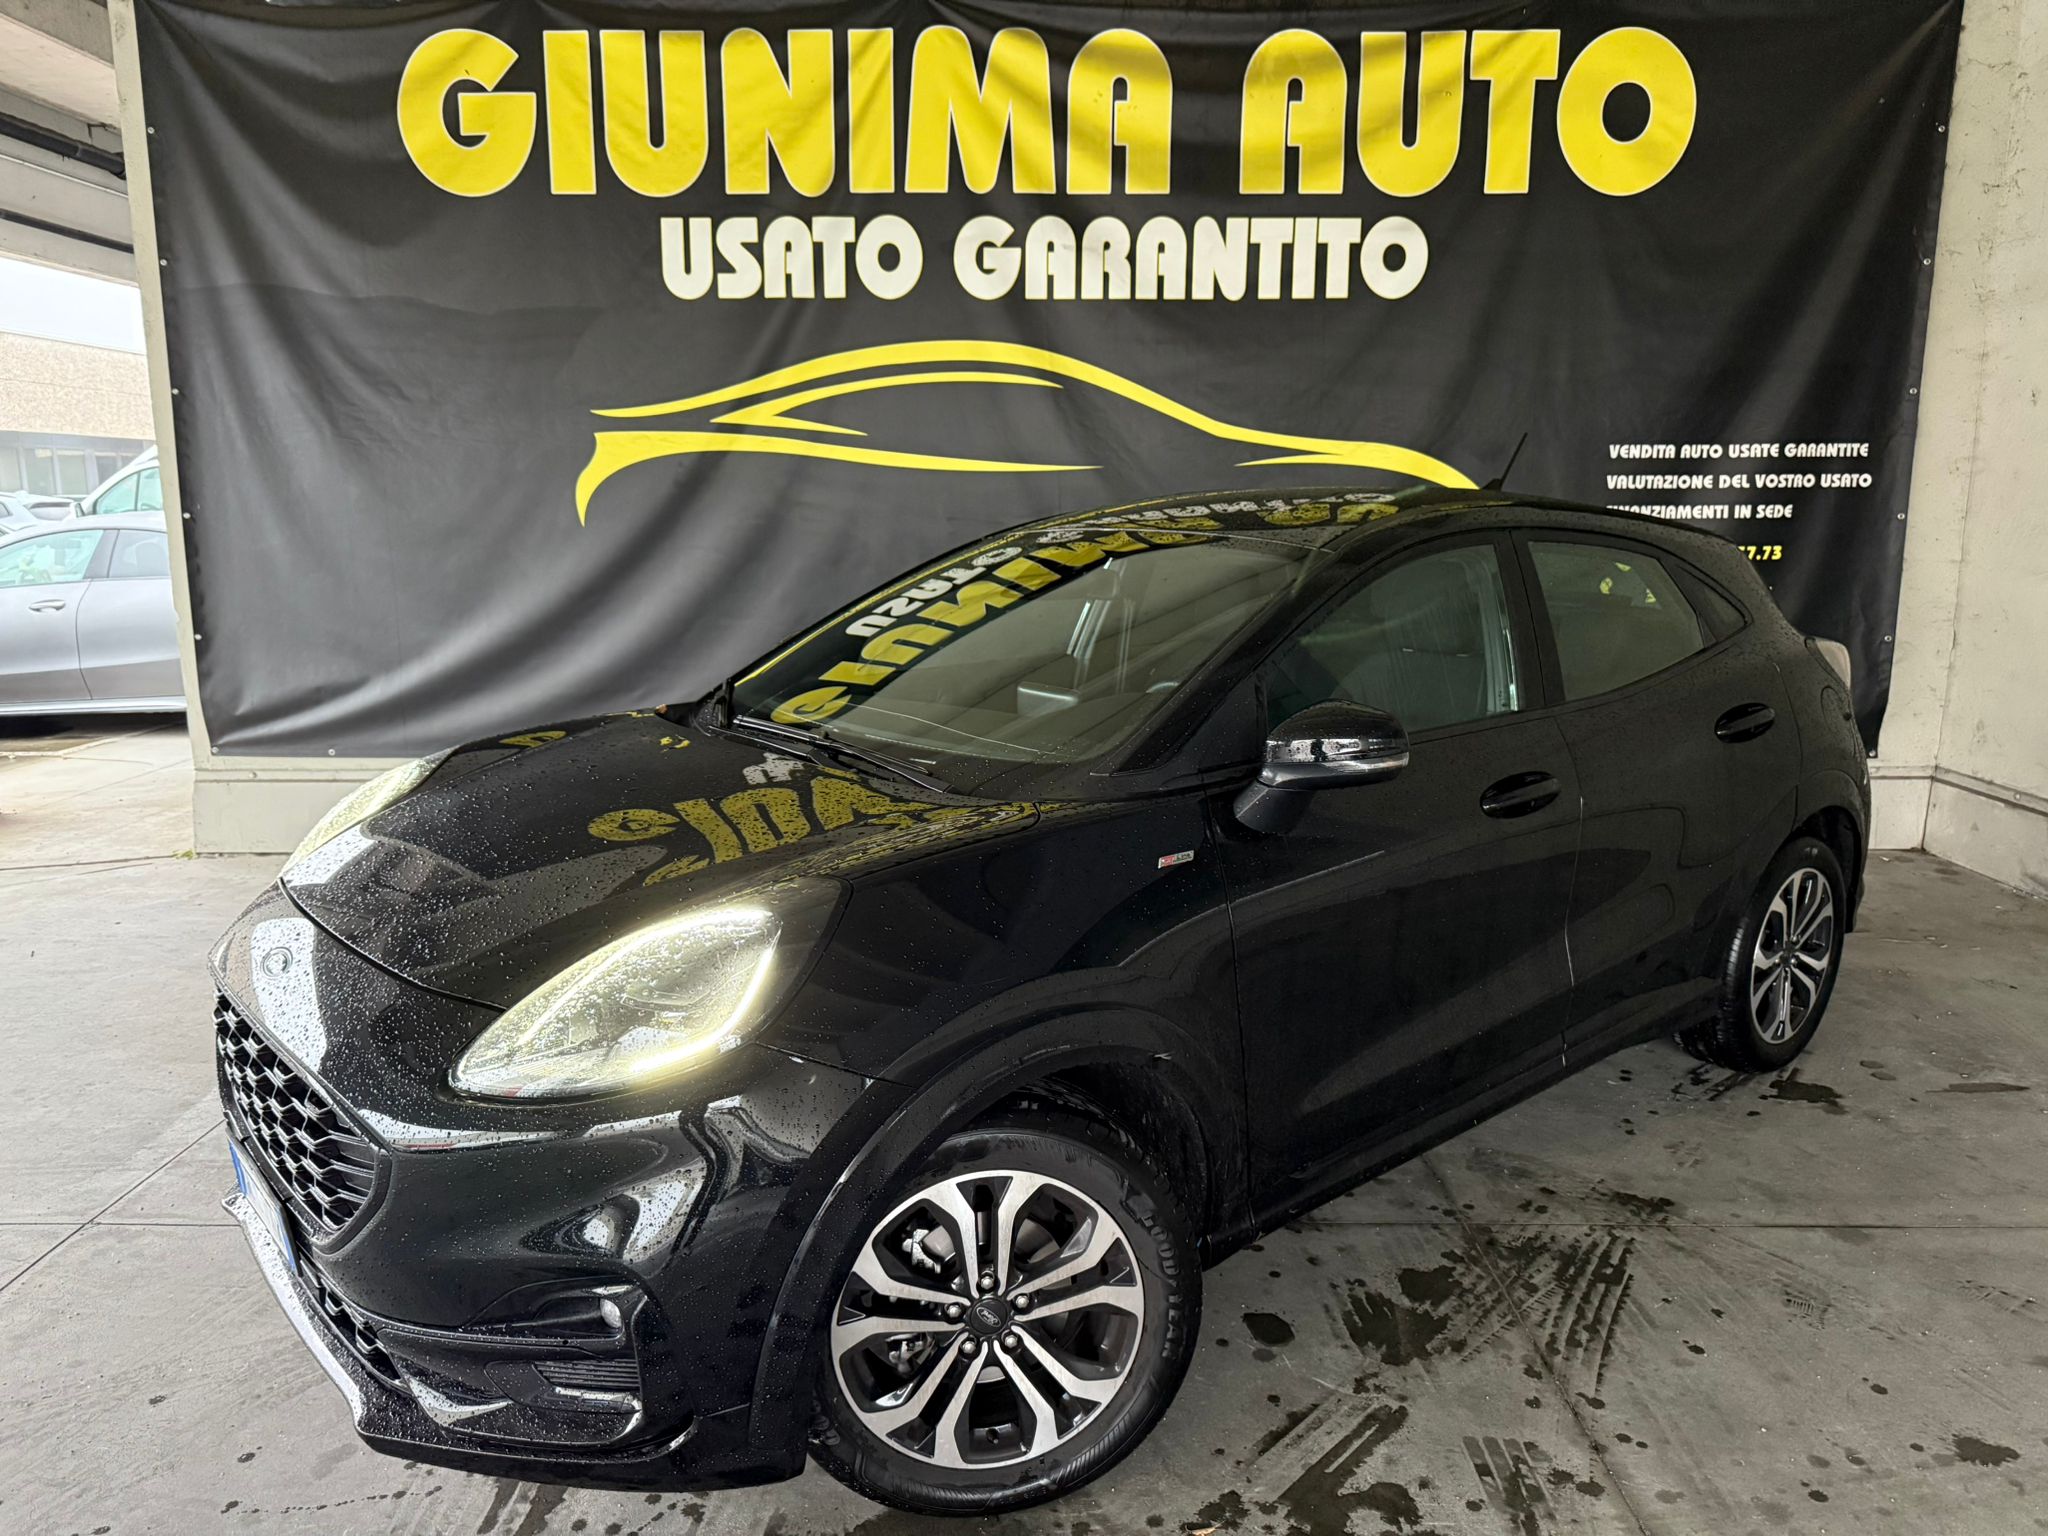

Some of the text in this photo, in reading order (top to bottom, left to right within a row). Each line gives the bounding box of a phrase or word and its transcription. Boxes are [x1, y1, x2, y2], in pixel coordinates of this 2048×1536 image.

[397, 25, 1698, 198] GIUNIMA AUTO
[659, 214, 1430, 303] USATO GARANTITO
[1608, 441, 1870, 460] VENDITA AUTO USATE GARANTITE
[1606, 472, 1873, 490] VALUTAZIONE DEL VOSTRO USATO
[1733, 504, 1753, 520] IN
[1755, 503, 1794, 520] SEDE
